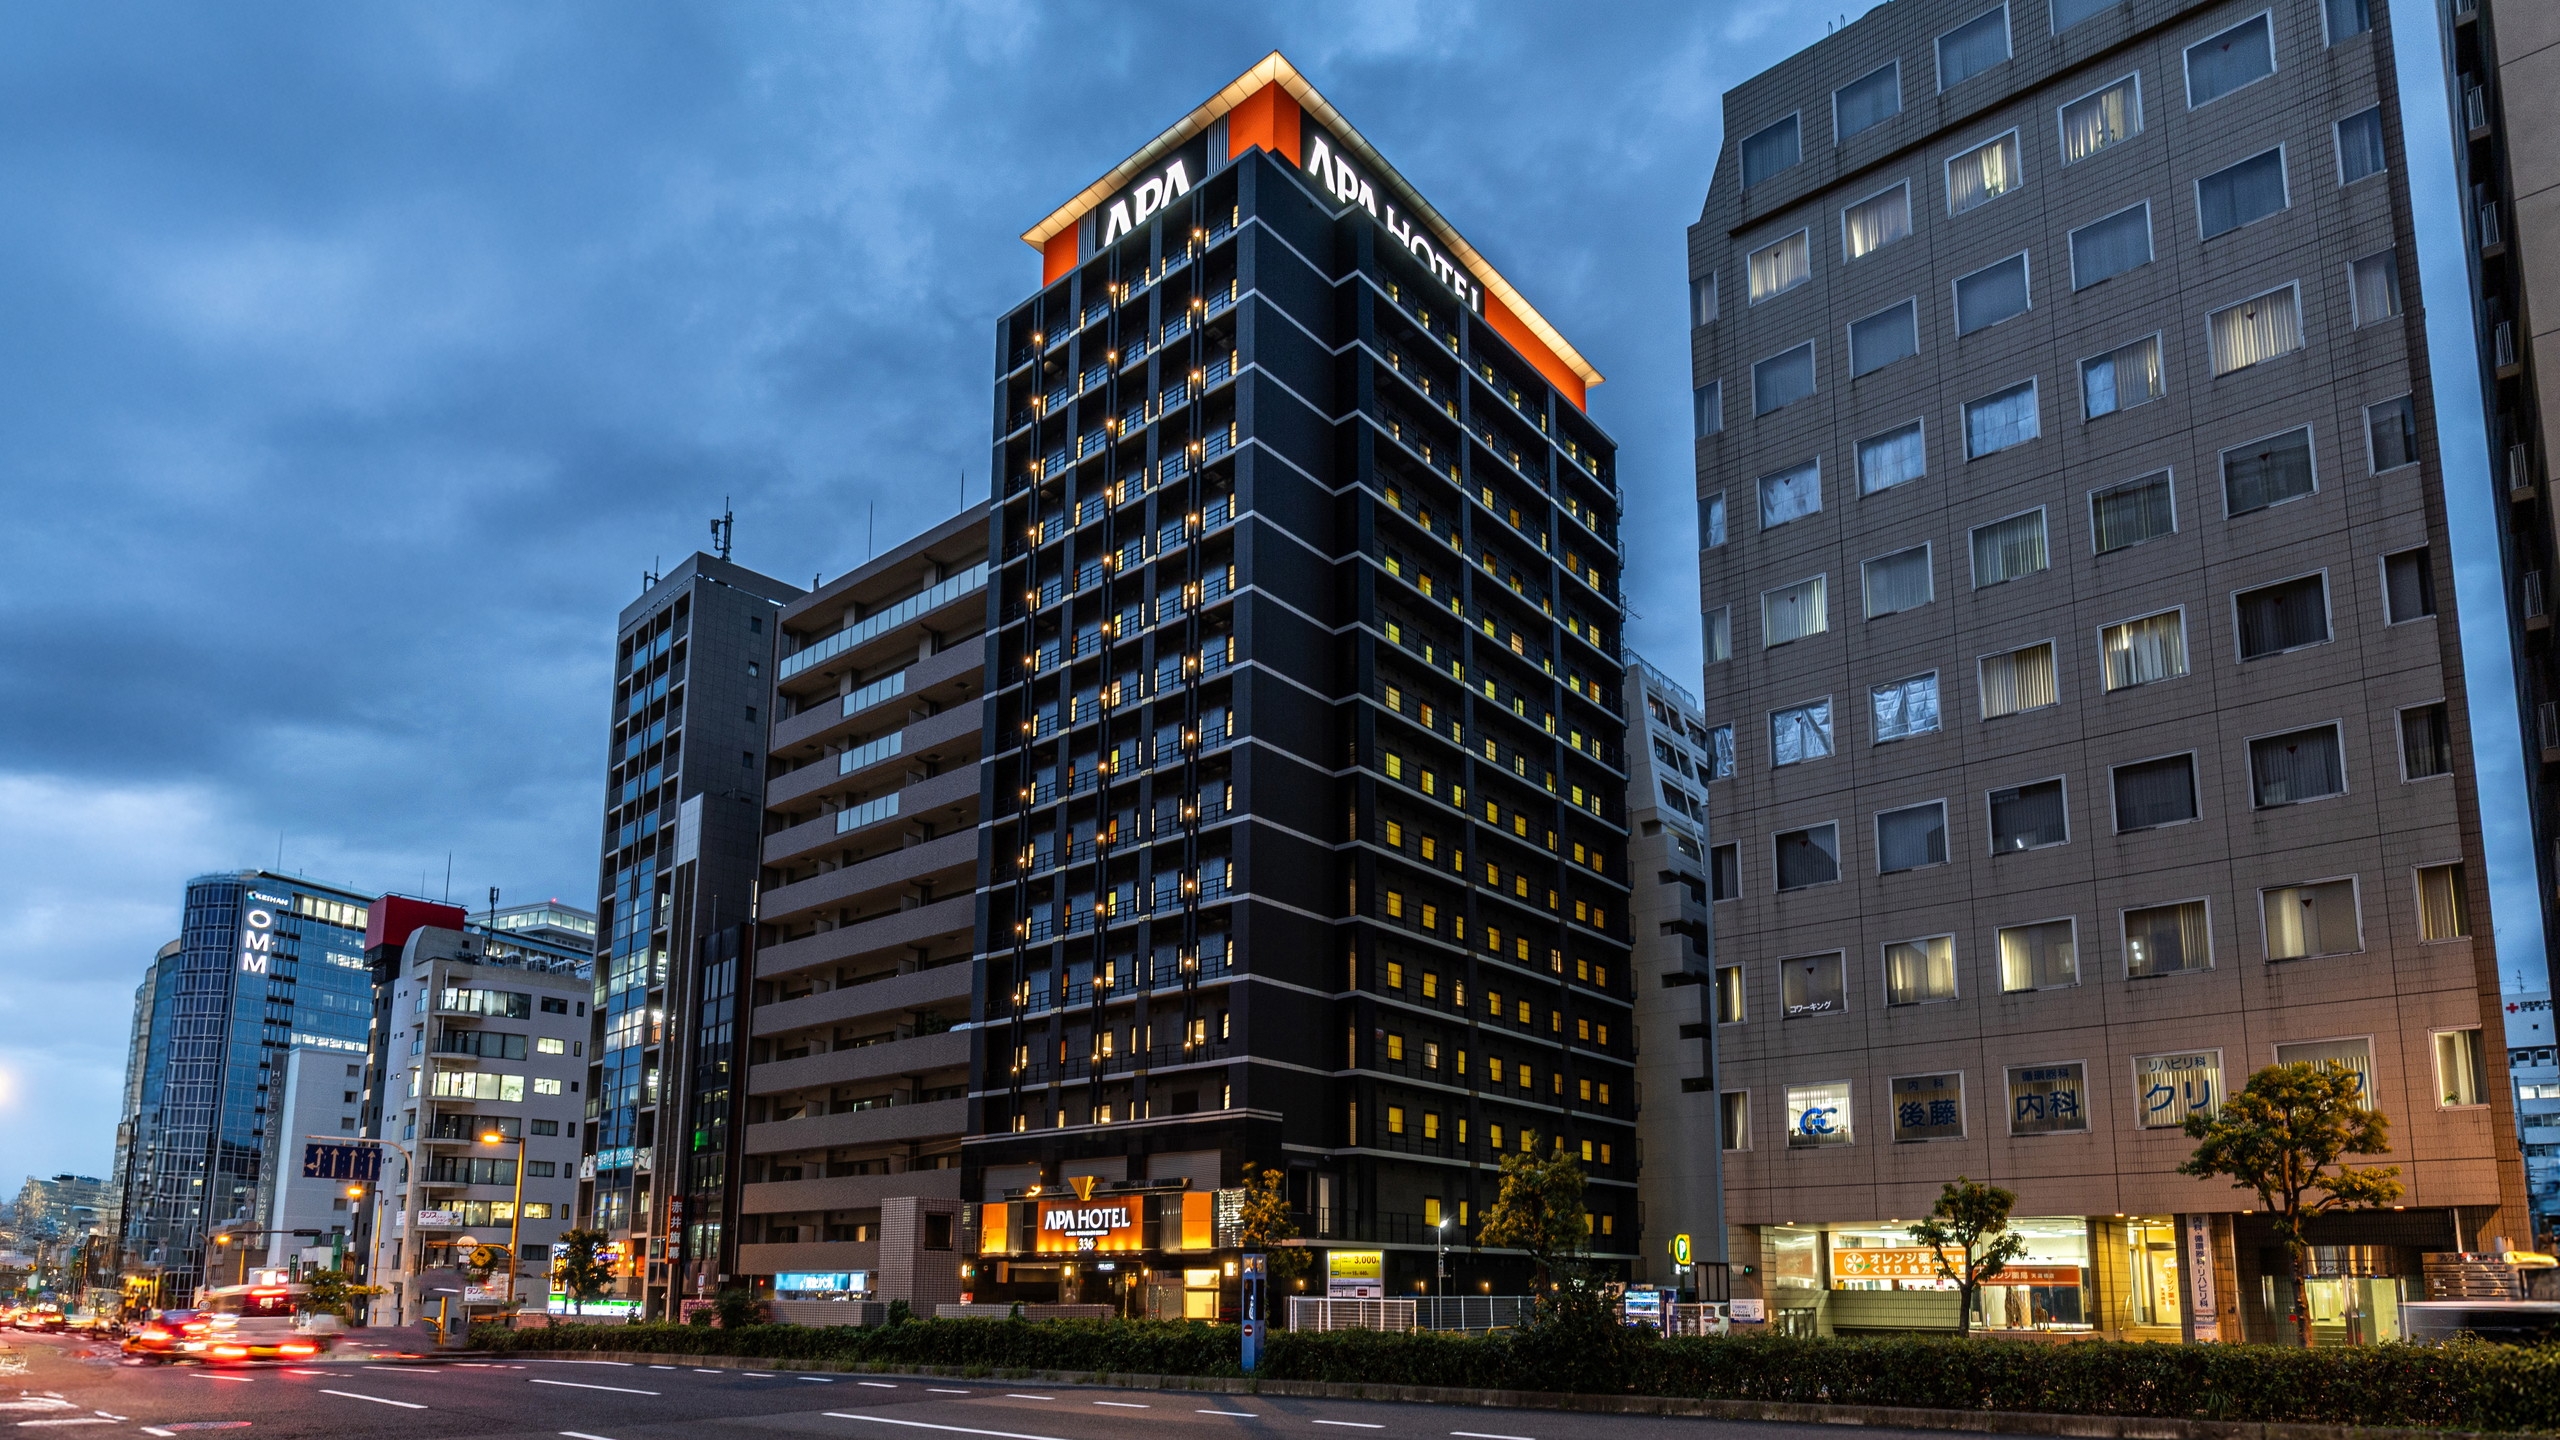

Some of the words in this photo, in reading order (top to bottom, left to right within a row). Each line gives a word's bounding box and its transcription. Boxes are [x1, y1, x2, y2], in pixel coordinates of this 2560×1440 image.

[1308, 136, 1377, 218] APA
[1104, 159, 1190, 247] APA
[255, 893, 288, 906] KEIHAN
[243, 910, 271, 974] OMM
[1790, 1001, 1832, 1013] コワーキング
[2148, 1056, 2207, 1072] リハビリ科
[269, 1070, 281, 1112] HOTEL
[1898, 1099, 1957, 1128] 後藤
[2016, 1089, 2079, 1120] 内科
[2145, 1079, 2210, 1112] クリ
[260, 1117, 275, 1182] KEIHAN
[668, 1201, 683, 1259] 赤井旗幕
[1045, 1209, 1075, 1230] APA
[1078, 1207, 1131, 1229] HOTEL
[1078, 1237, 1094, 1250] 336
[1679, 1240, 1686, 1259] P
[1870, 1252, 1943, 1264] オレンジ薬
[1872, 1266, 1902, 1274] くすり
